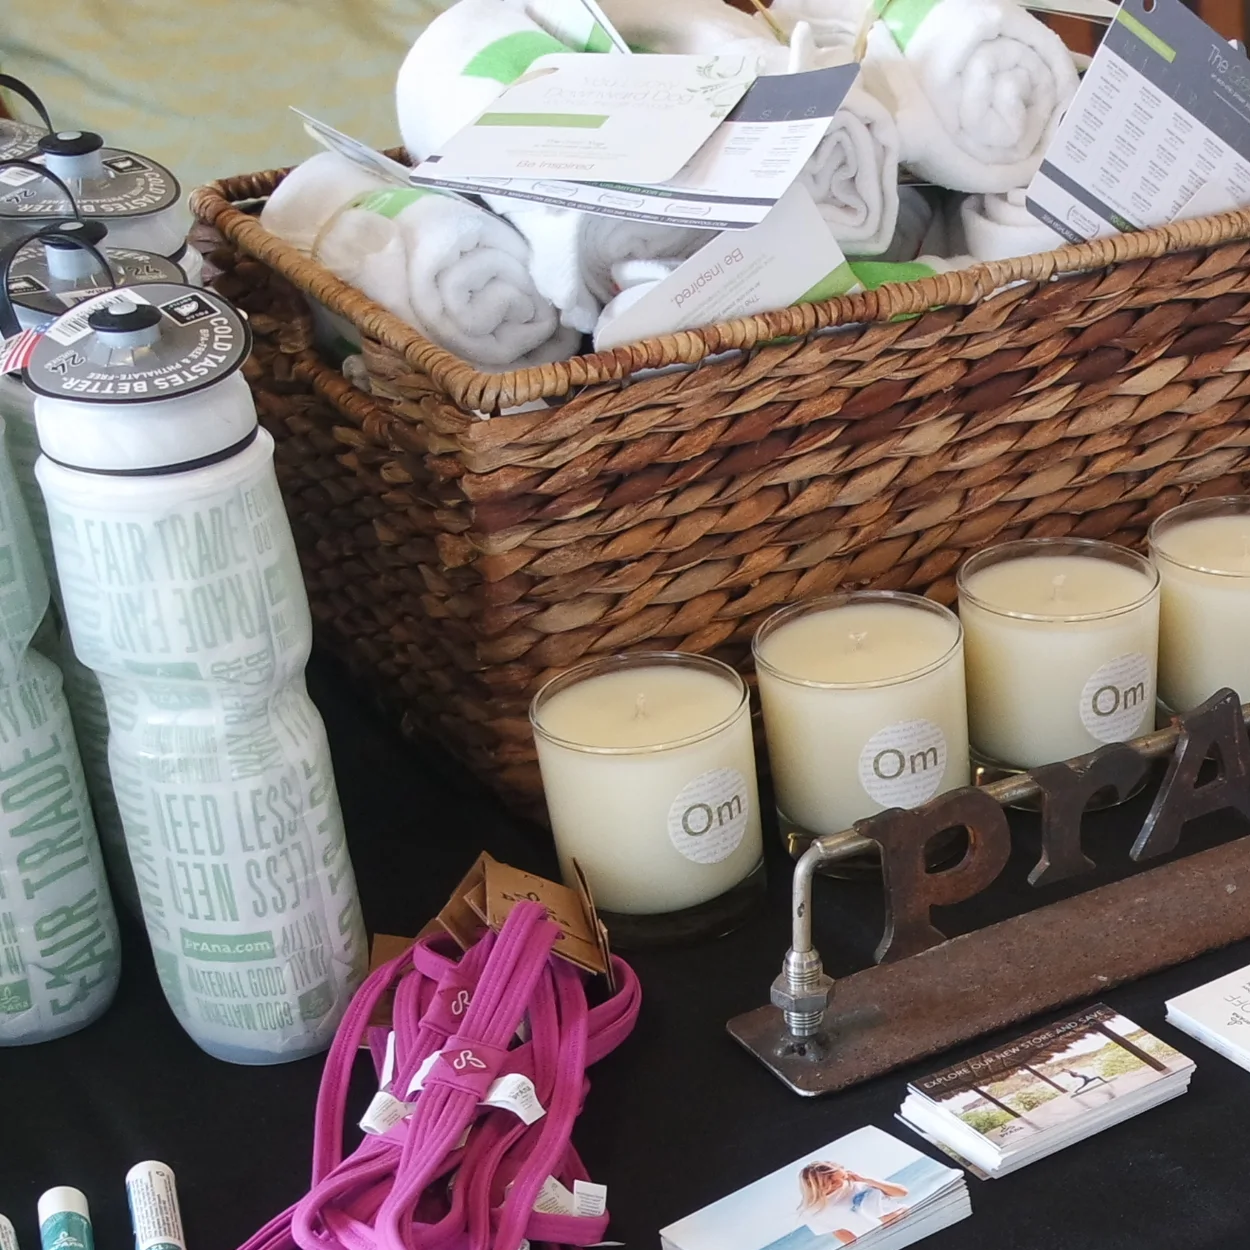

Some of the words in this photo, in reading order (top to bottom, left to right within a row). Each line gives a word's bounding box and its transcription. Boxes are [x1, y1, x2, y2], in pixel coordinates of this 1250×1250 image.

[1207, 44, 1229, 74] The
[724, 247, 744, 267] Be
[210, 316, 233, 351] COLD
[86, 364, 182, 382] PHTHALATE-FREE
[157, 351, 227, 391] TASTES
[84, 519, 154, 586] FAIR
[154, 497, 249, 581] TRADE
[1091, 678, 1146, 717] Om
[872, 744, 939, 781] Om
[0, 733, 91, 900] TRADE
[233, 776, 304, 853] LESS
[681, 795, 743, 838] Om
[33, 888, 113, 1016] FAIR
[249, 966, 287, 997] GOOD
[923, 1068, 972, 1090] EXPLORE
[970, 1055, 995, 1070] OUR
[995, 1046, 1021, 1061] NEW
[1020, 1032, 1054, 1050] STORE
[1055, 1021, 1078, 1036] AND
[1078, 1009, 1106, 1026] SAVE
